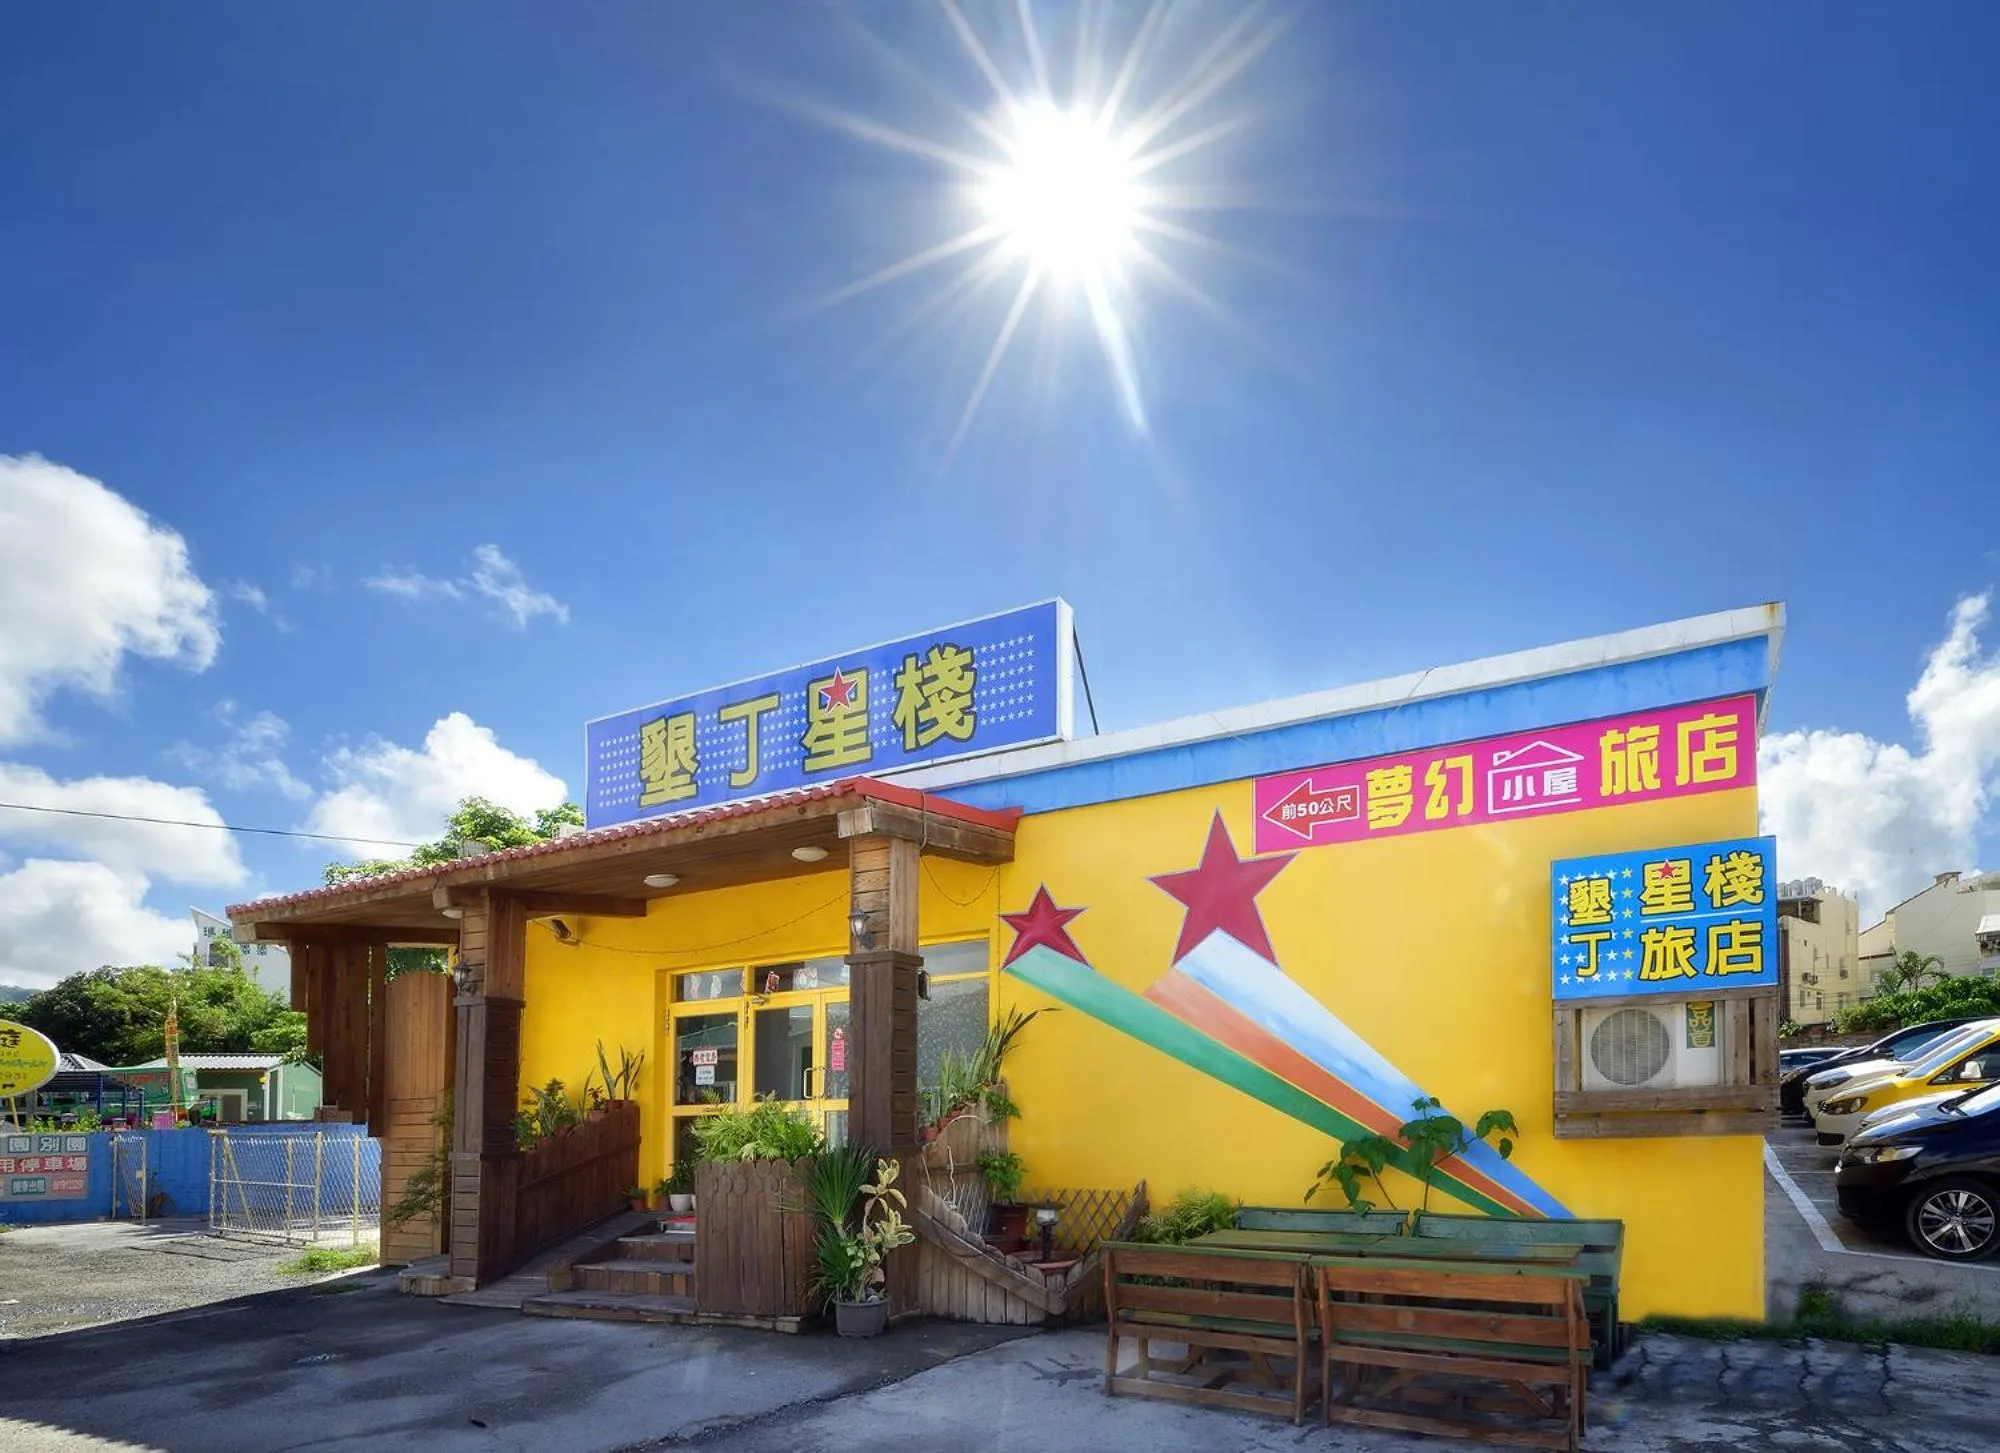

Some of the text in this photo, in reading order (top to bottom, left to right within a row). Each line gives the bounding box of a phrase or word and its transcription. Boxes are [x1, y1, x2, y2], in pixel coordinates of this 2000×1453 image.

[638, 642, 978, 809] 墾丁星棧
[1281, 794, 1352, 821] 前50公尺
[1502, 766, 1578, 801] 小屋
[1638, 849, 1765, 916] 星棧
[1637, 919, 1764, 982] 旅店
